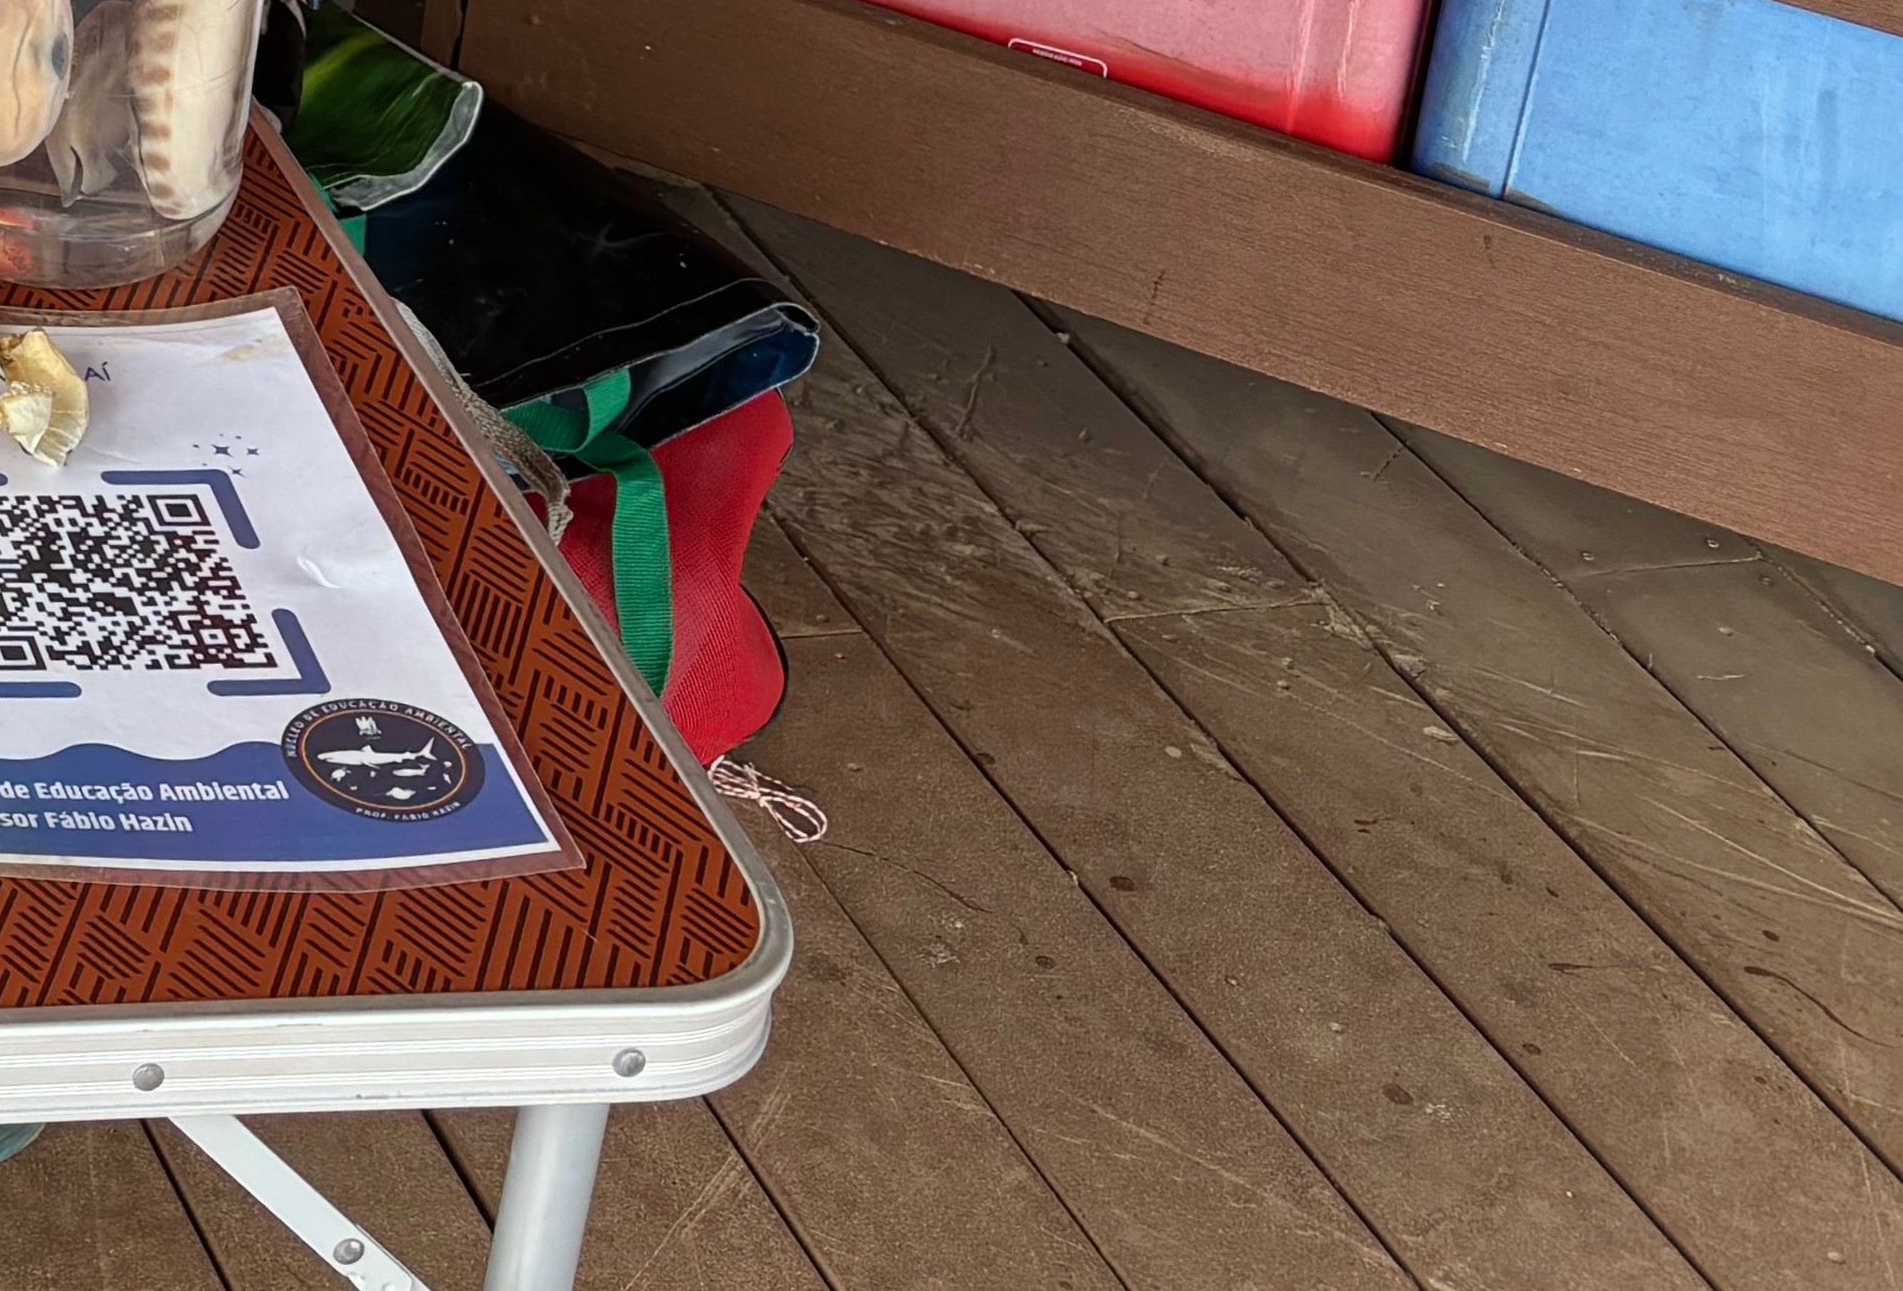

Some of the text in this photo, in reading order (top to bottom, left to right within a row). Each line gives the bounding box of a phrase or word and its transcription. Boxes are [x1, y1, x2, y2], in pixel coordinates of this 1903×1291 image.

[84, 361, 111, 382] AÍ
[321, 700, 400, 716] EDUCAÇÃO
[404, 707, 474, 750] AMBIENTAL
[33, 779, 154, 805] Educação
[158, 779, 290, 801] Ambiental
[44, 809, 117, 832] Fábio
[121, 811, 194, 833] Hazin
